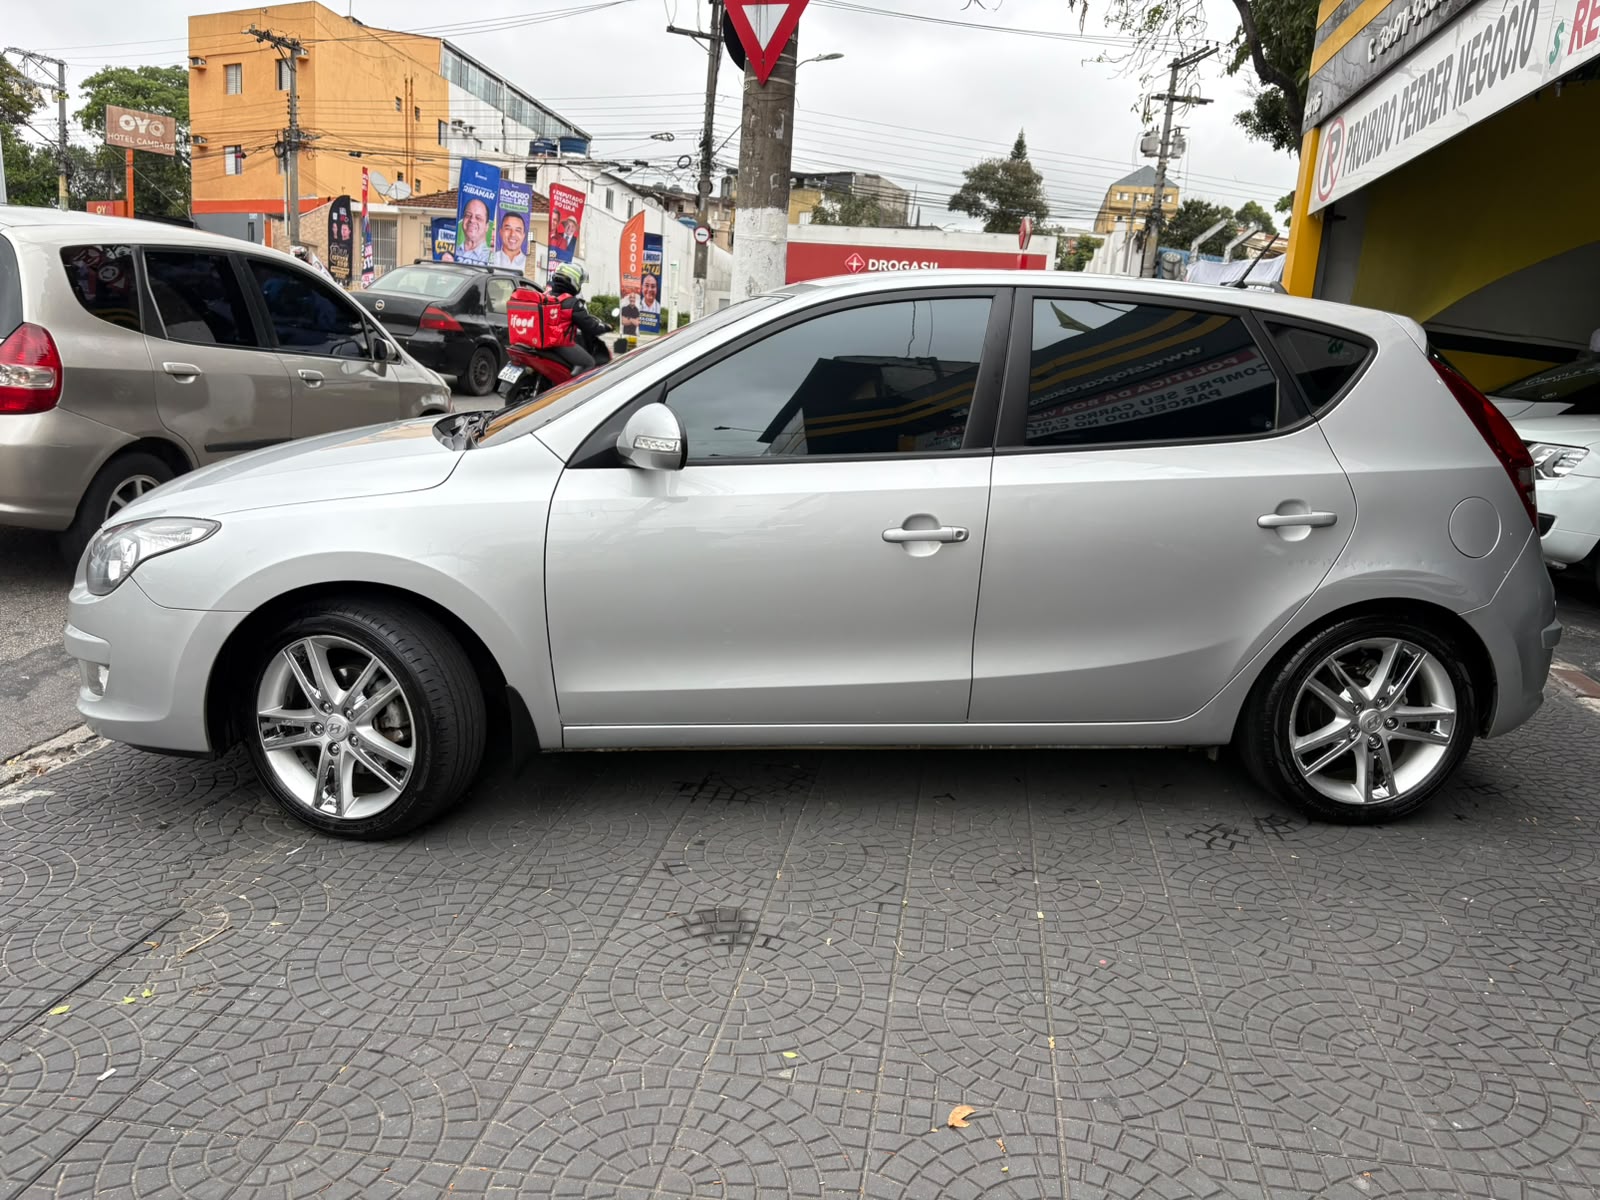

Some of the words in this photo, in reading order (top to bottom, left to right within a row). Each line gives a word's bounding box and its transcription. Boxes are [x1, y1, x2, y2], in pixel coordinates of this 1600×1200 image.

[1342, 94, 1397, 177] PROIBIDO
[1396, 53, 1454, 145] PERDER
[1452, 0, 1539, 111] NEGÓCIO
[119, 114, 165, 137] OYO
[107, 132, 135, 144] HOTEL
[462, 185, 496, 201] RIBAMAR
[555, 189, 584, 204] DEPUTADO
[553, 194, 579, 208] ESTADUAL
[562, 204, 576, 213] LULA
[630, 233, 638, 273] 2000
